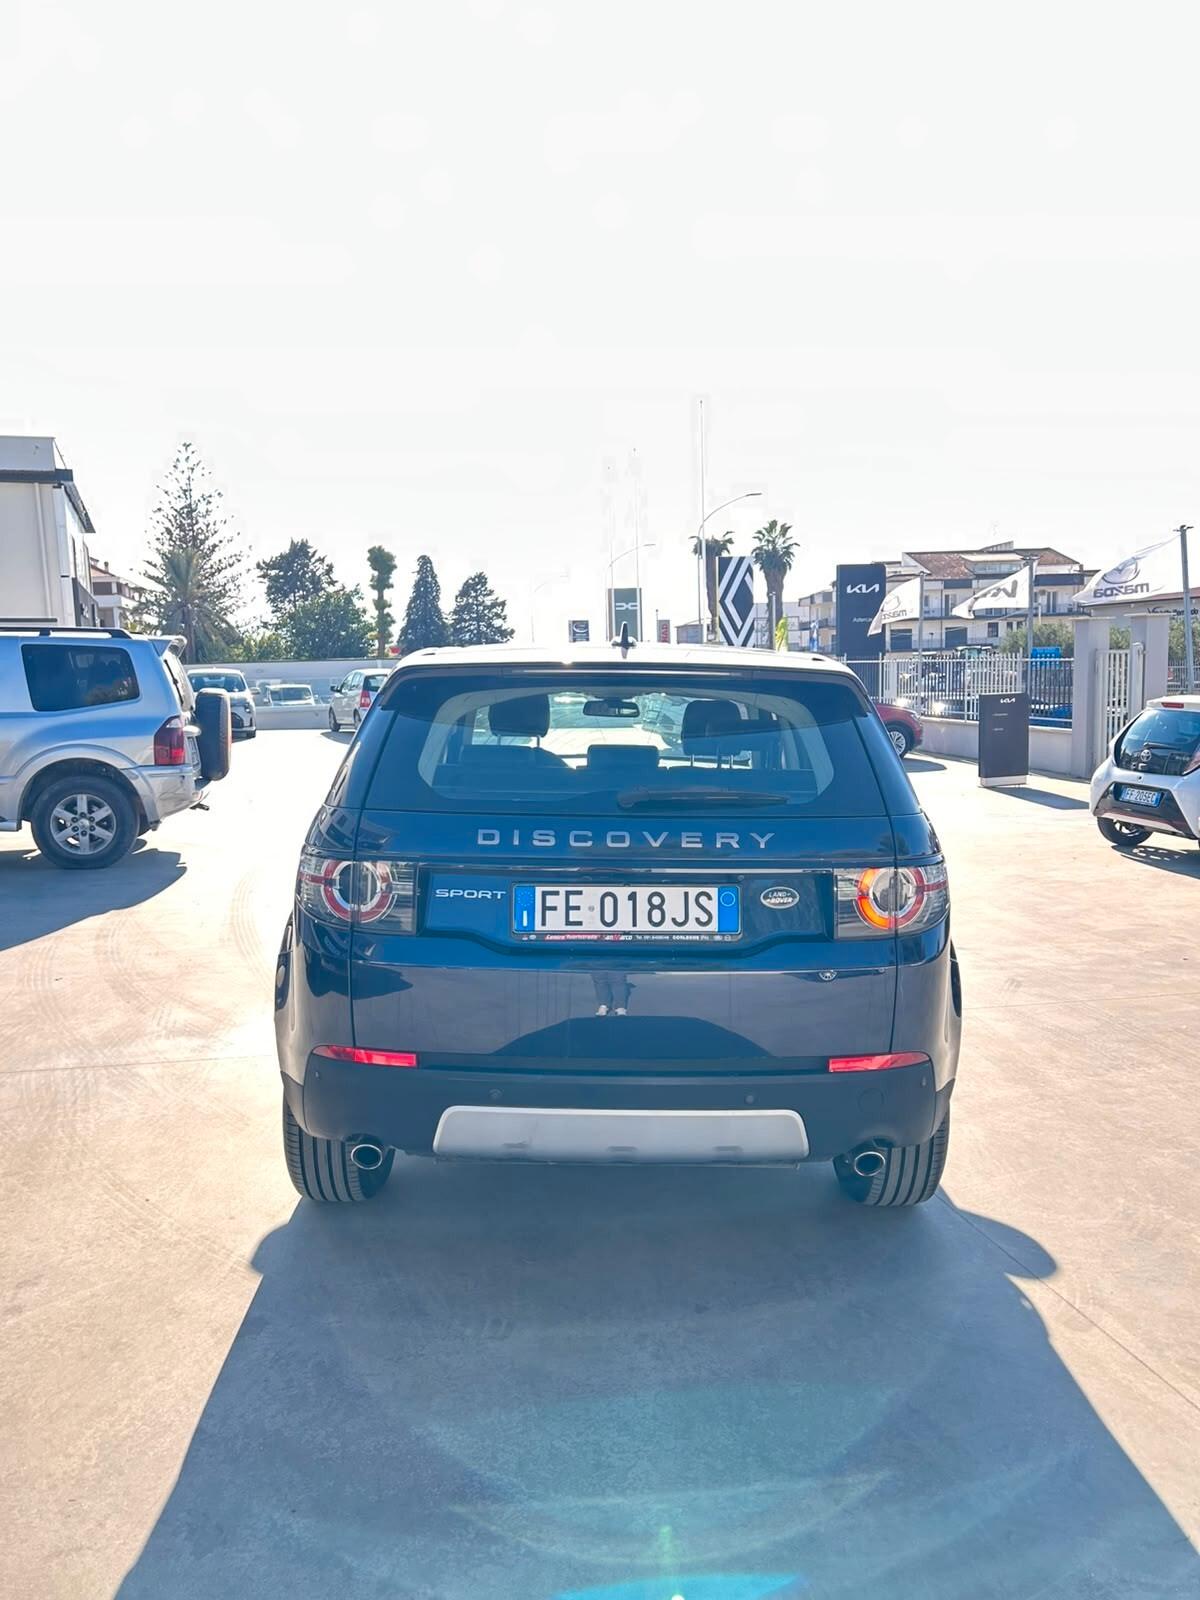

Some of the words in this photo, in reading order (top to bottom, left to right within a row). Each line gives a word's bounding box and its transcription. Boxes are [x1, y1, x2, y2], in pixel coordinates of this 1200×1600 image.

[846, 583, 880, 594] KIA
[477, 829, 776, 849] DISCOVERY
[435, 888, 507, 900] SPORT
[541, 890, 583, 927] FE
[600, 891, 713, 928] 018JS
